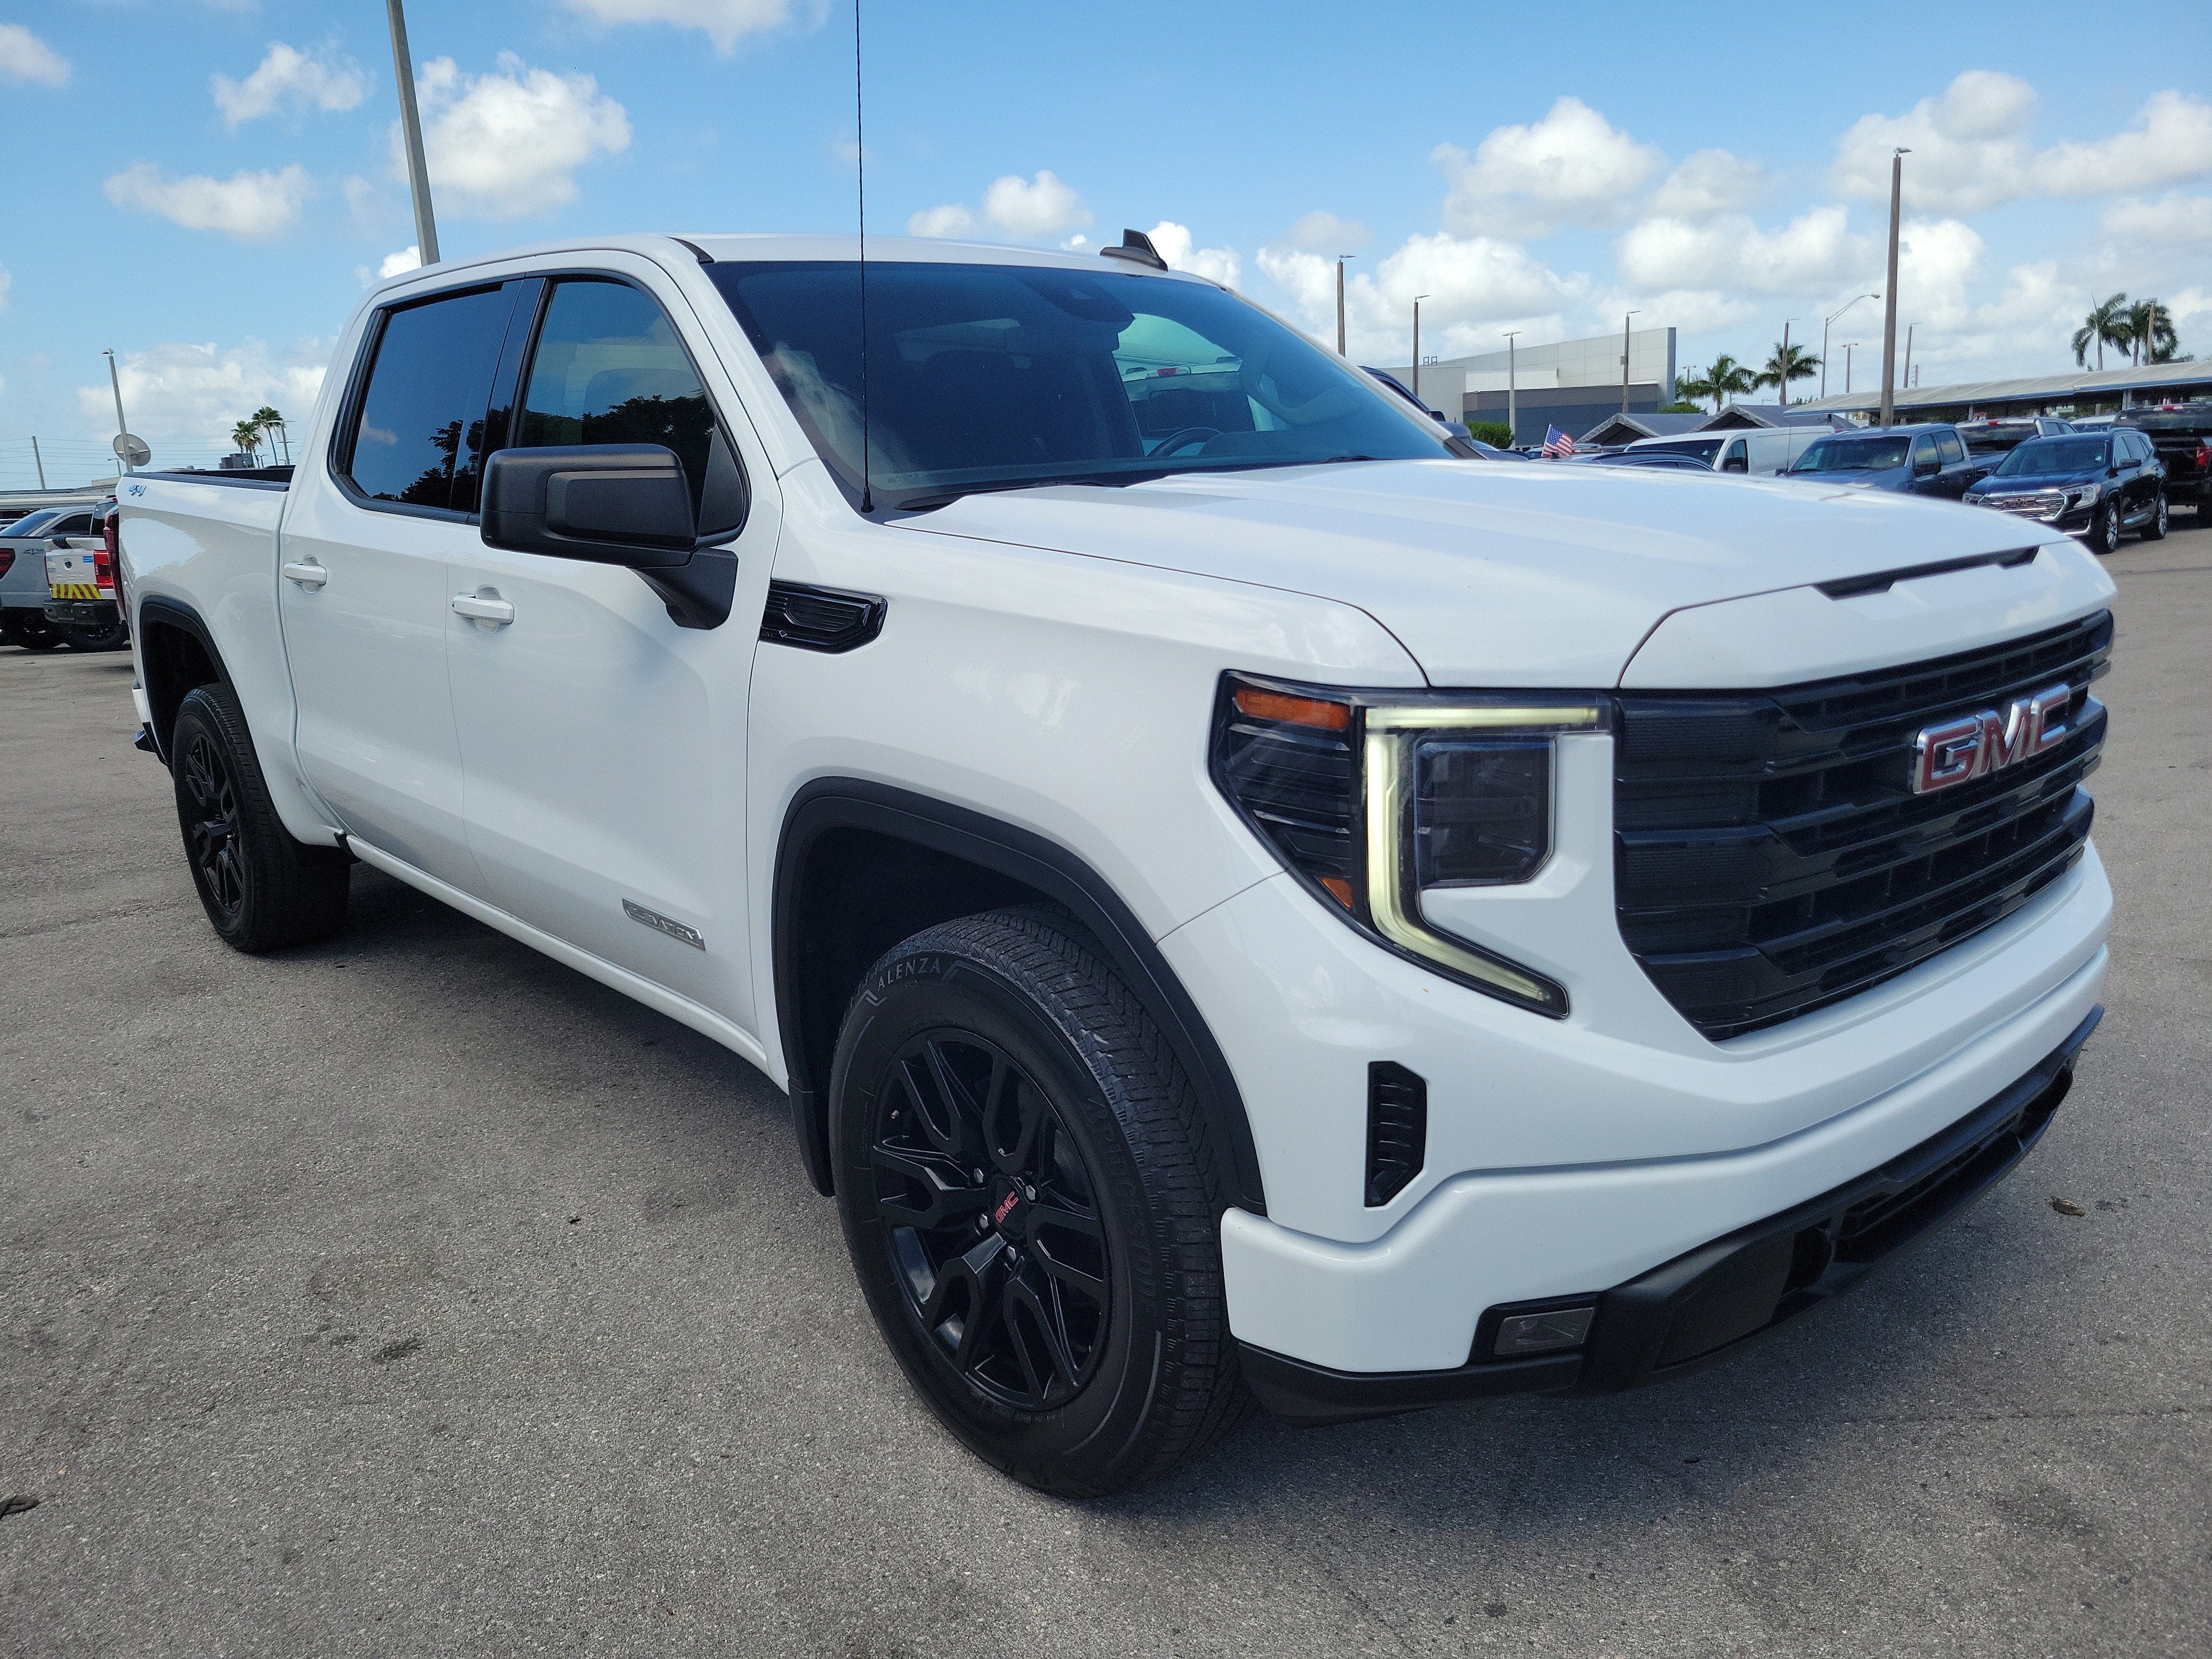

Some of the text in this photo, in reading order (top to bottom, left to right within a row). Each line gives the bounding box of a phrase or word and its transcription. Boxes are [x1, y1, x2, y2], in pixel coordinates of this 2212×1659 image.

[1913, 683, 2070, 794] GMC
[877, 957, 941, 991] ALENZA
[995, 1190, 1019, 1224] GMC
